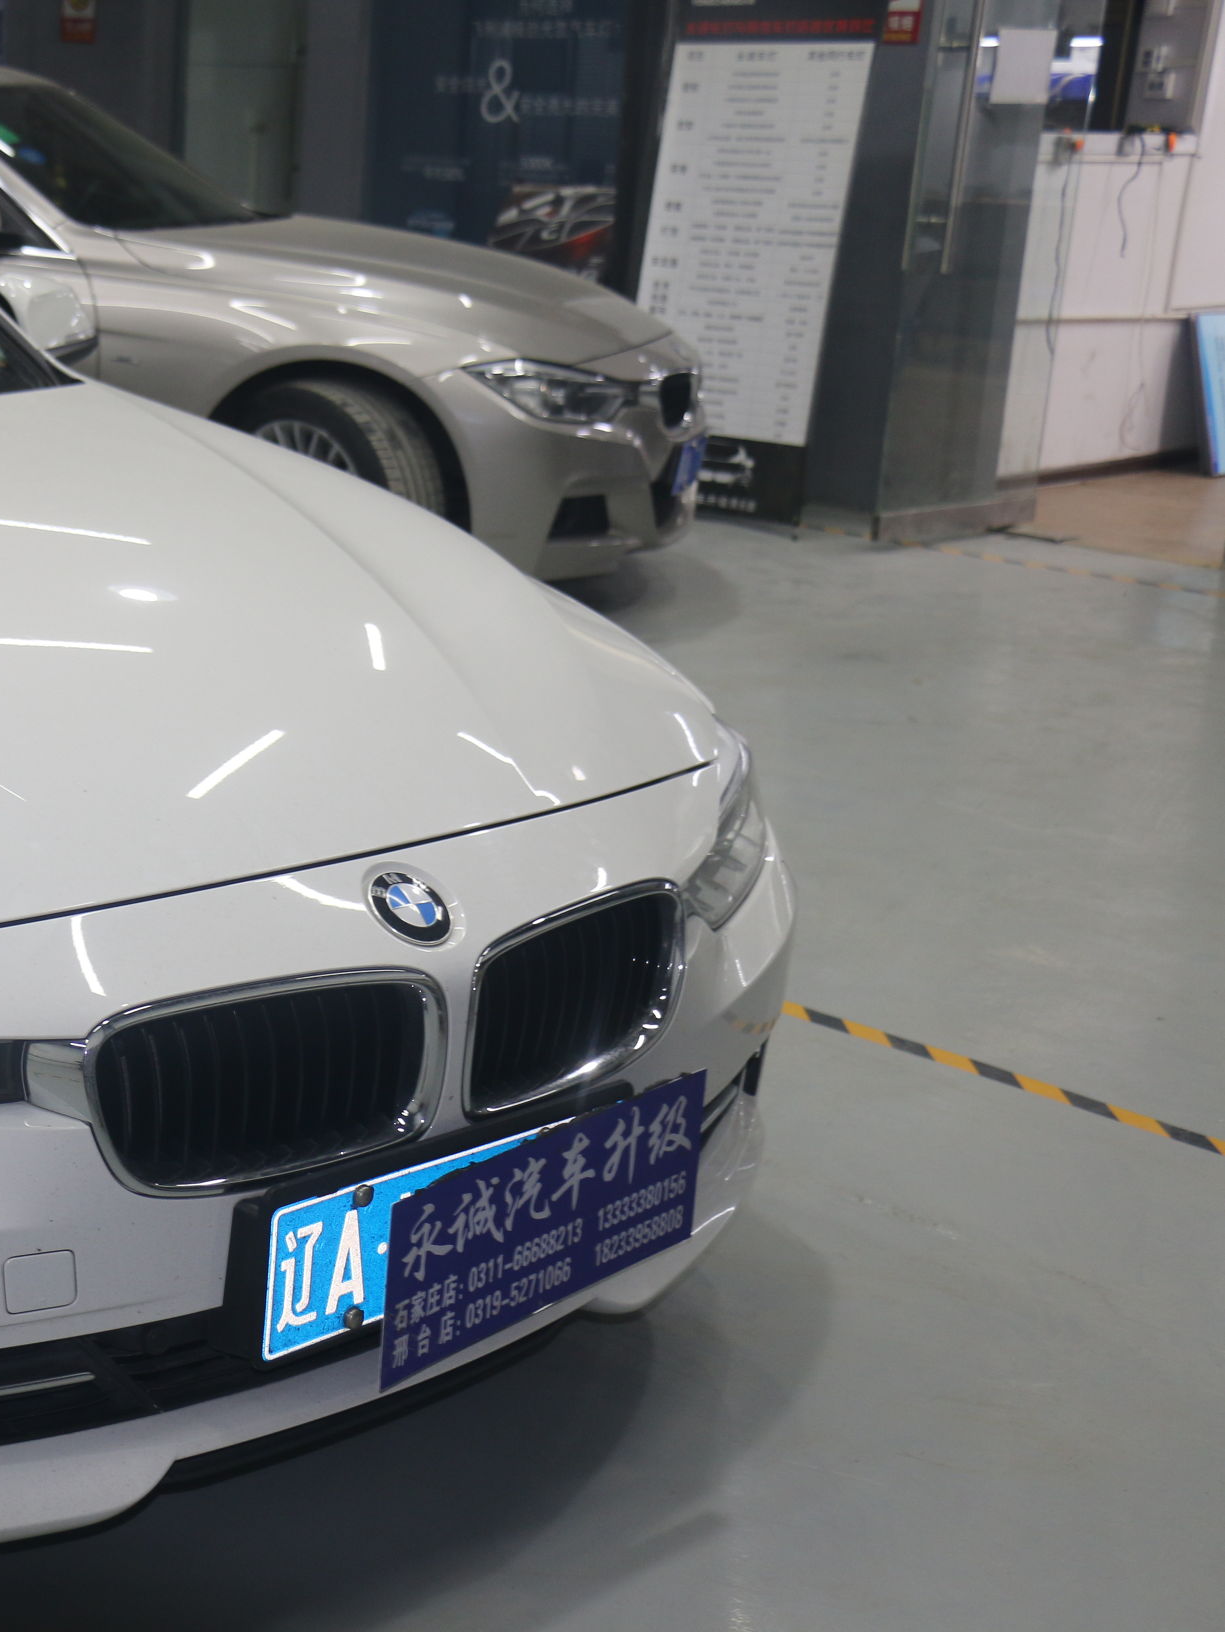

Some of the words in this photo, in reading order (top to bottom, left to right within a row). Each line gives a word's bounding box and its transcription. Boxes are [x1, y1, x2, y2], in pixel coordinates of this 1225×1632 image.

[480, 58, 520, 124] &
[401, 1095, 692, 1283] 永诚汽车升级
[468, 1218, 584, 1292] 0311-66688213
[598, 1170, 687, 1232] 13333380156
[465, 1257, 572, 1329] 0319-5271066
